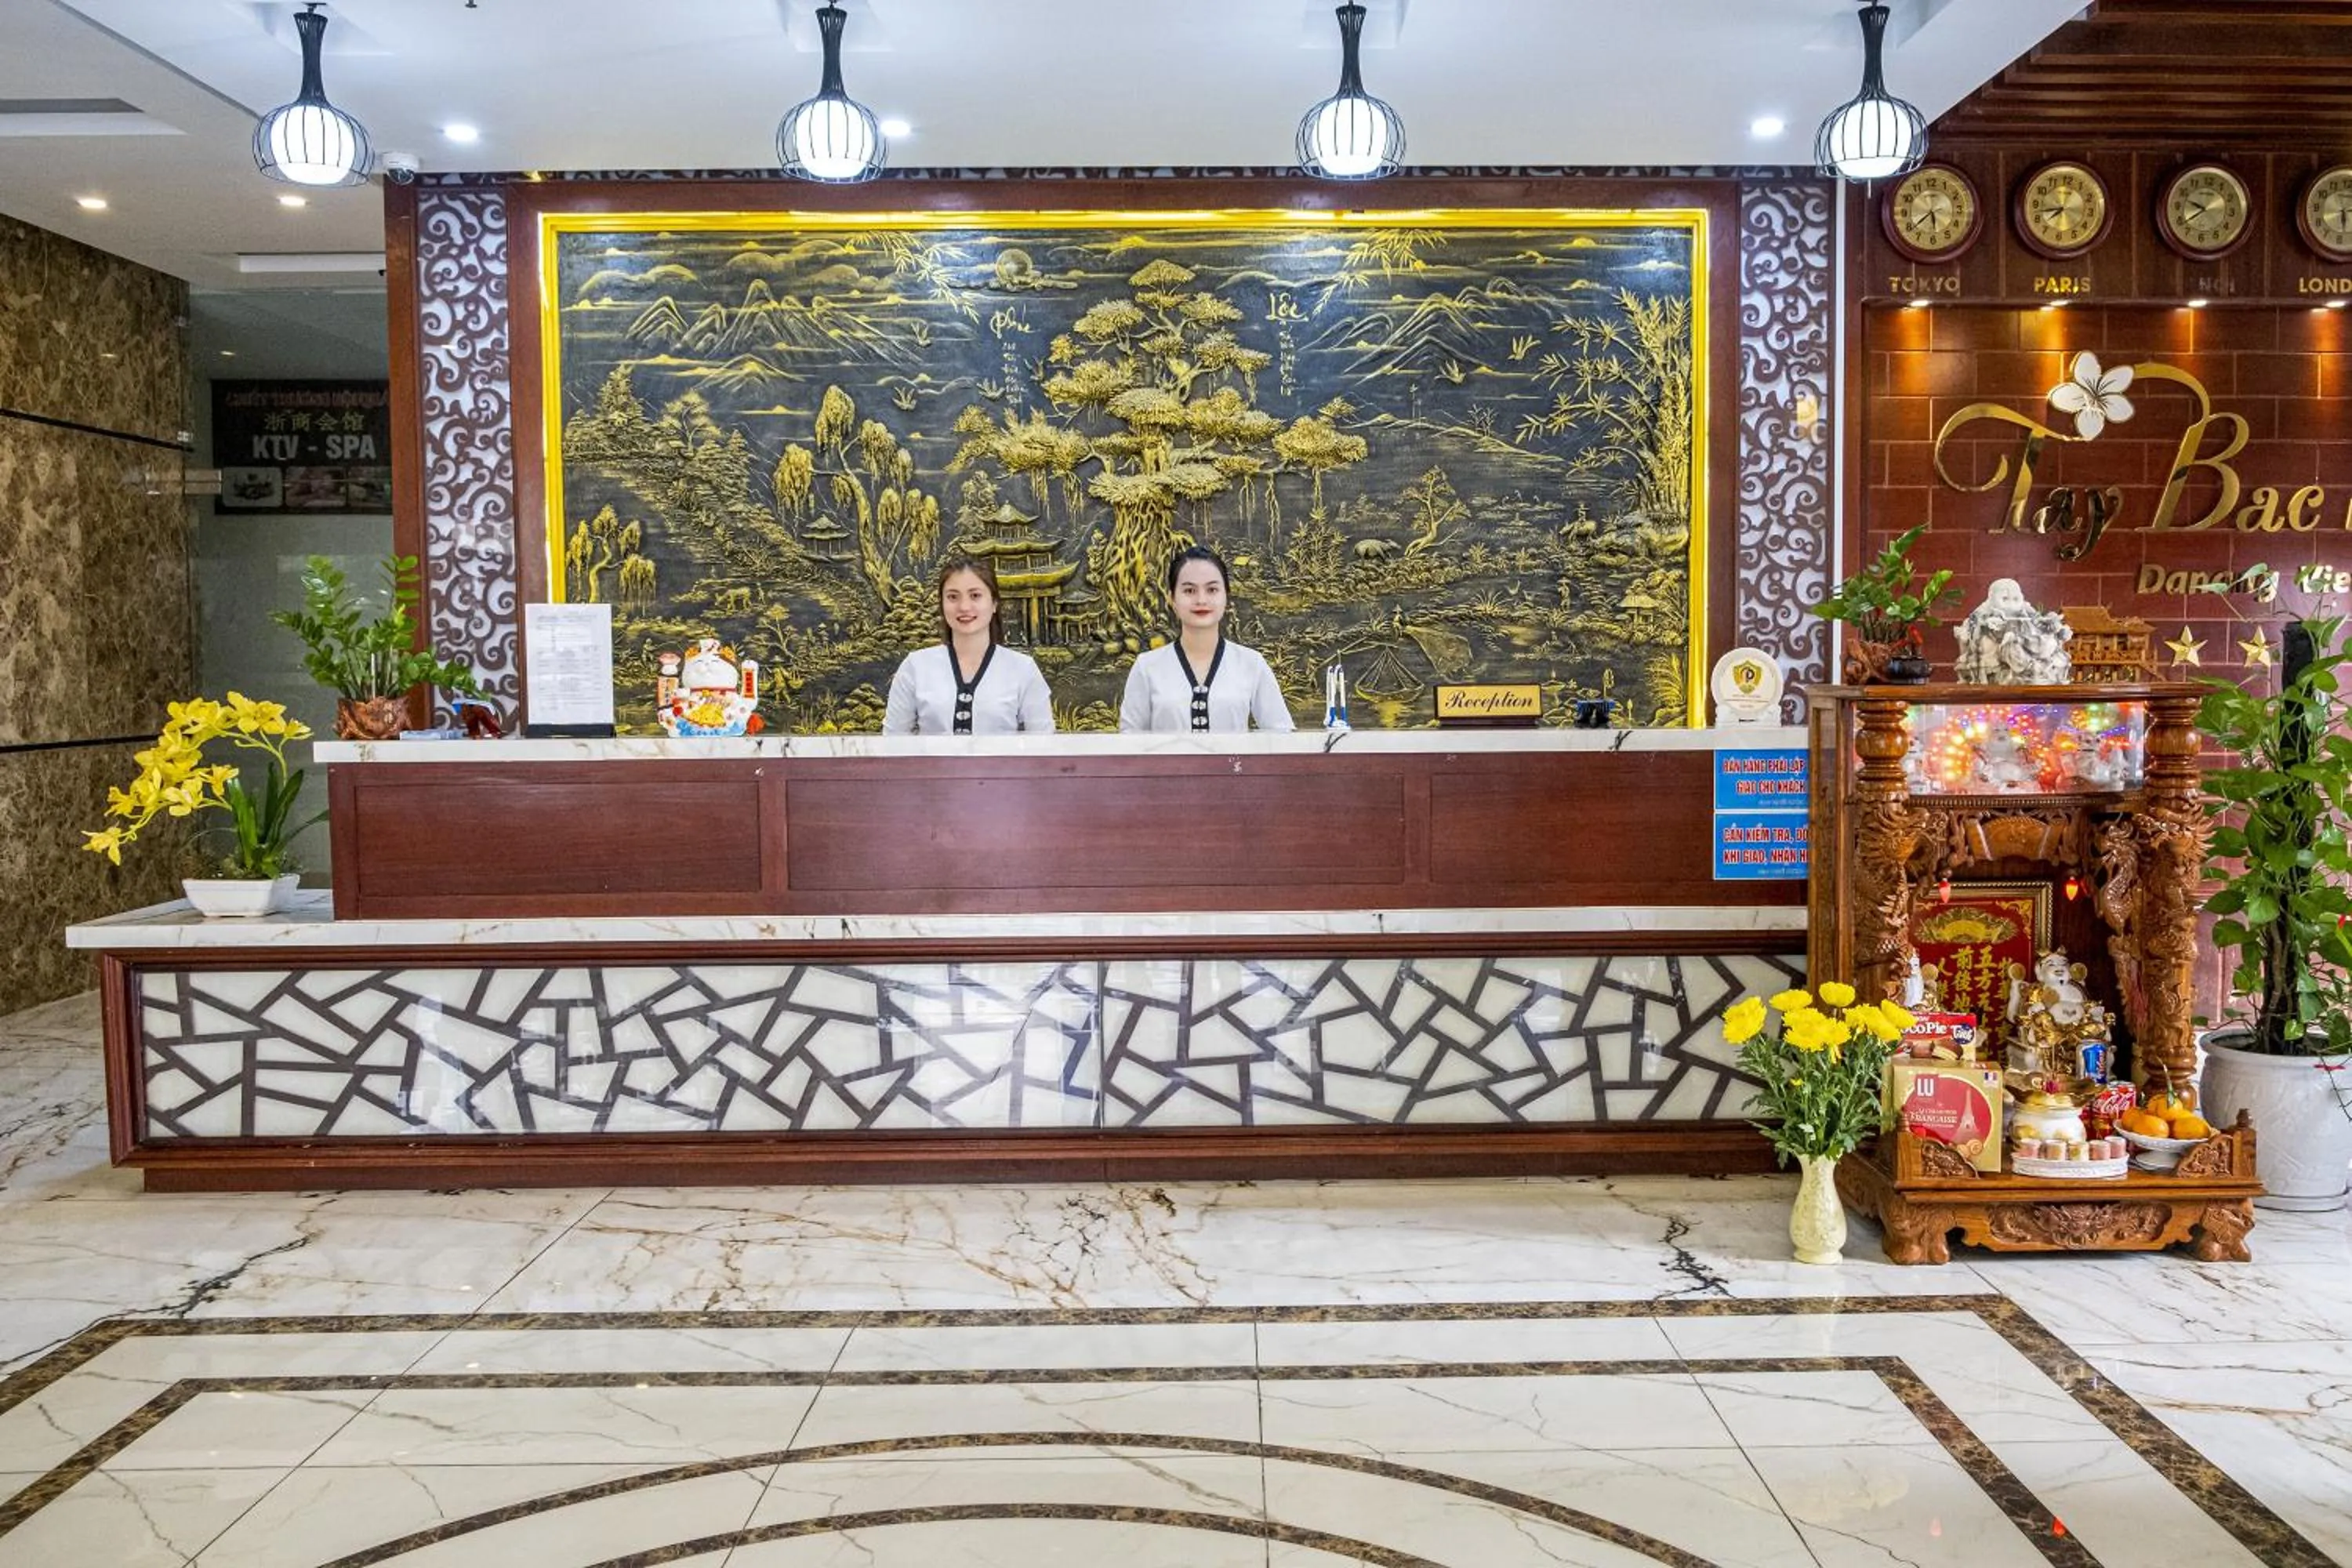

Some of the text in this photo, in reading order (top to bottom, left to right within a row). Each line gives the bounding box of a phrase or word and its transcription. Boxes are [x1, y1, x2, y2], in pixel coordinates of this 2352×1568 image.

[1926, 178, 1936, 187] 12
[1888, 277, 1958, 292] TOKYO
[2034, 277, 2092, 293] PARIS
[2299, 277, 2352, 294] LOND
[252, 434, 299, 459] KTV
[325, 434, 377, 459] SPA
[1933, 362, 2325, 562] Tay Bac
[1444, 689, 1534, 713] Reception
[1799, 848, 1809, 864] H
[1917, 1078, 1934, 1097] LU
